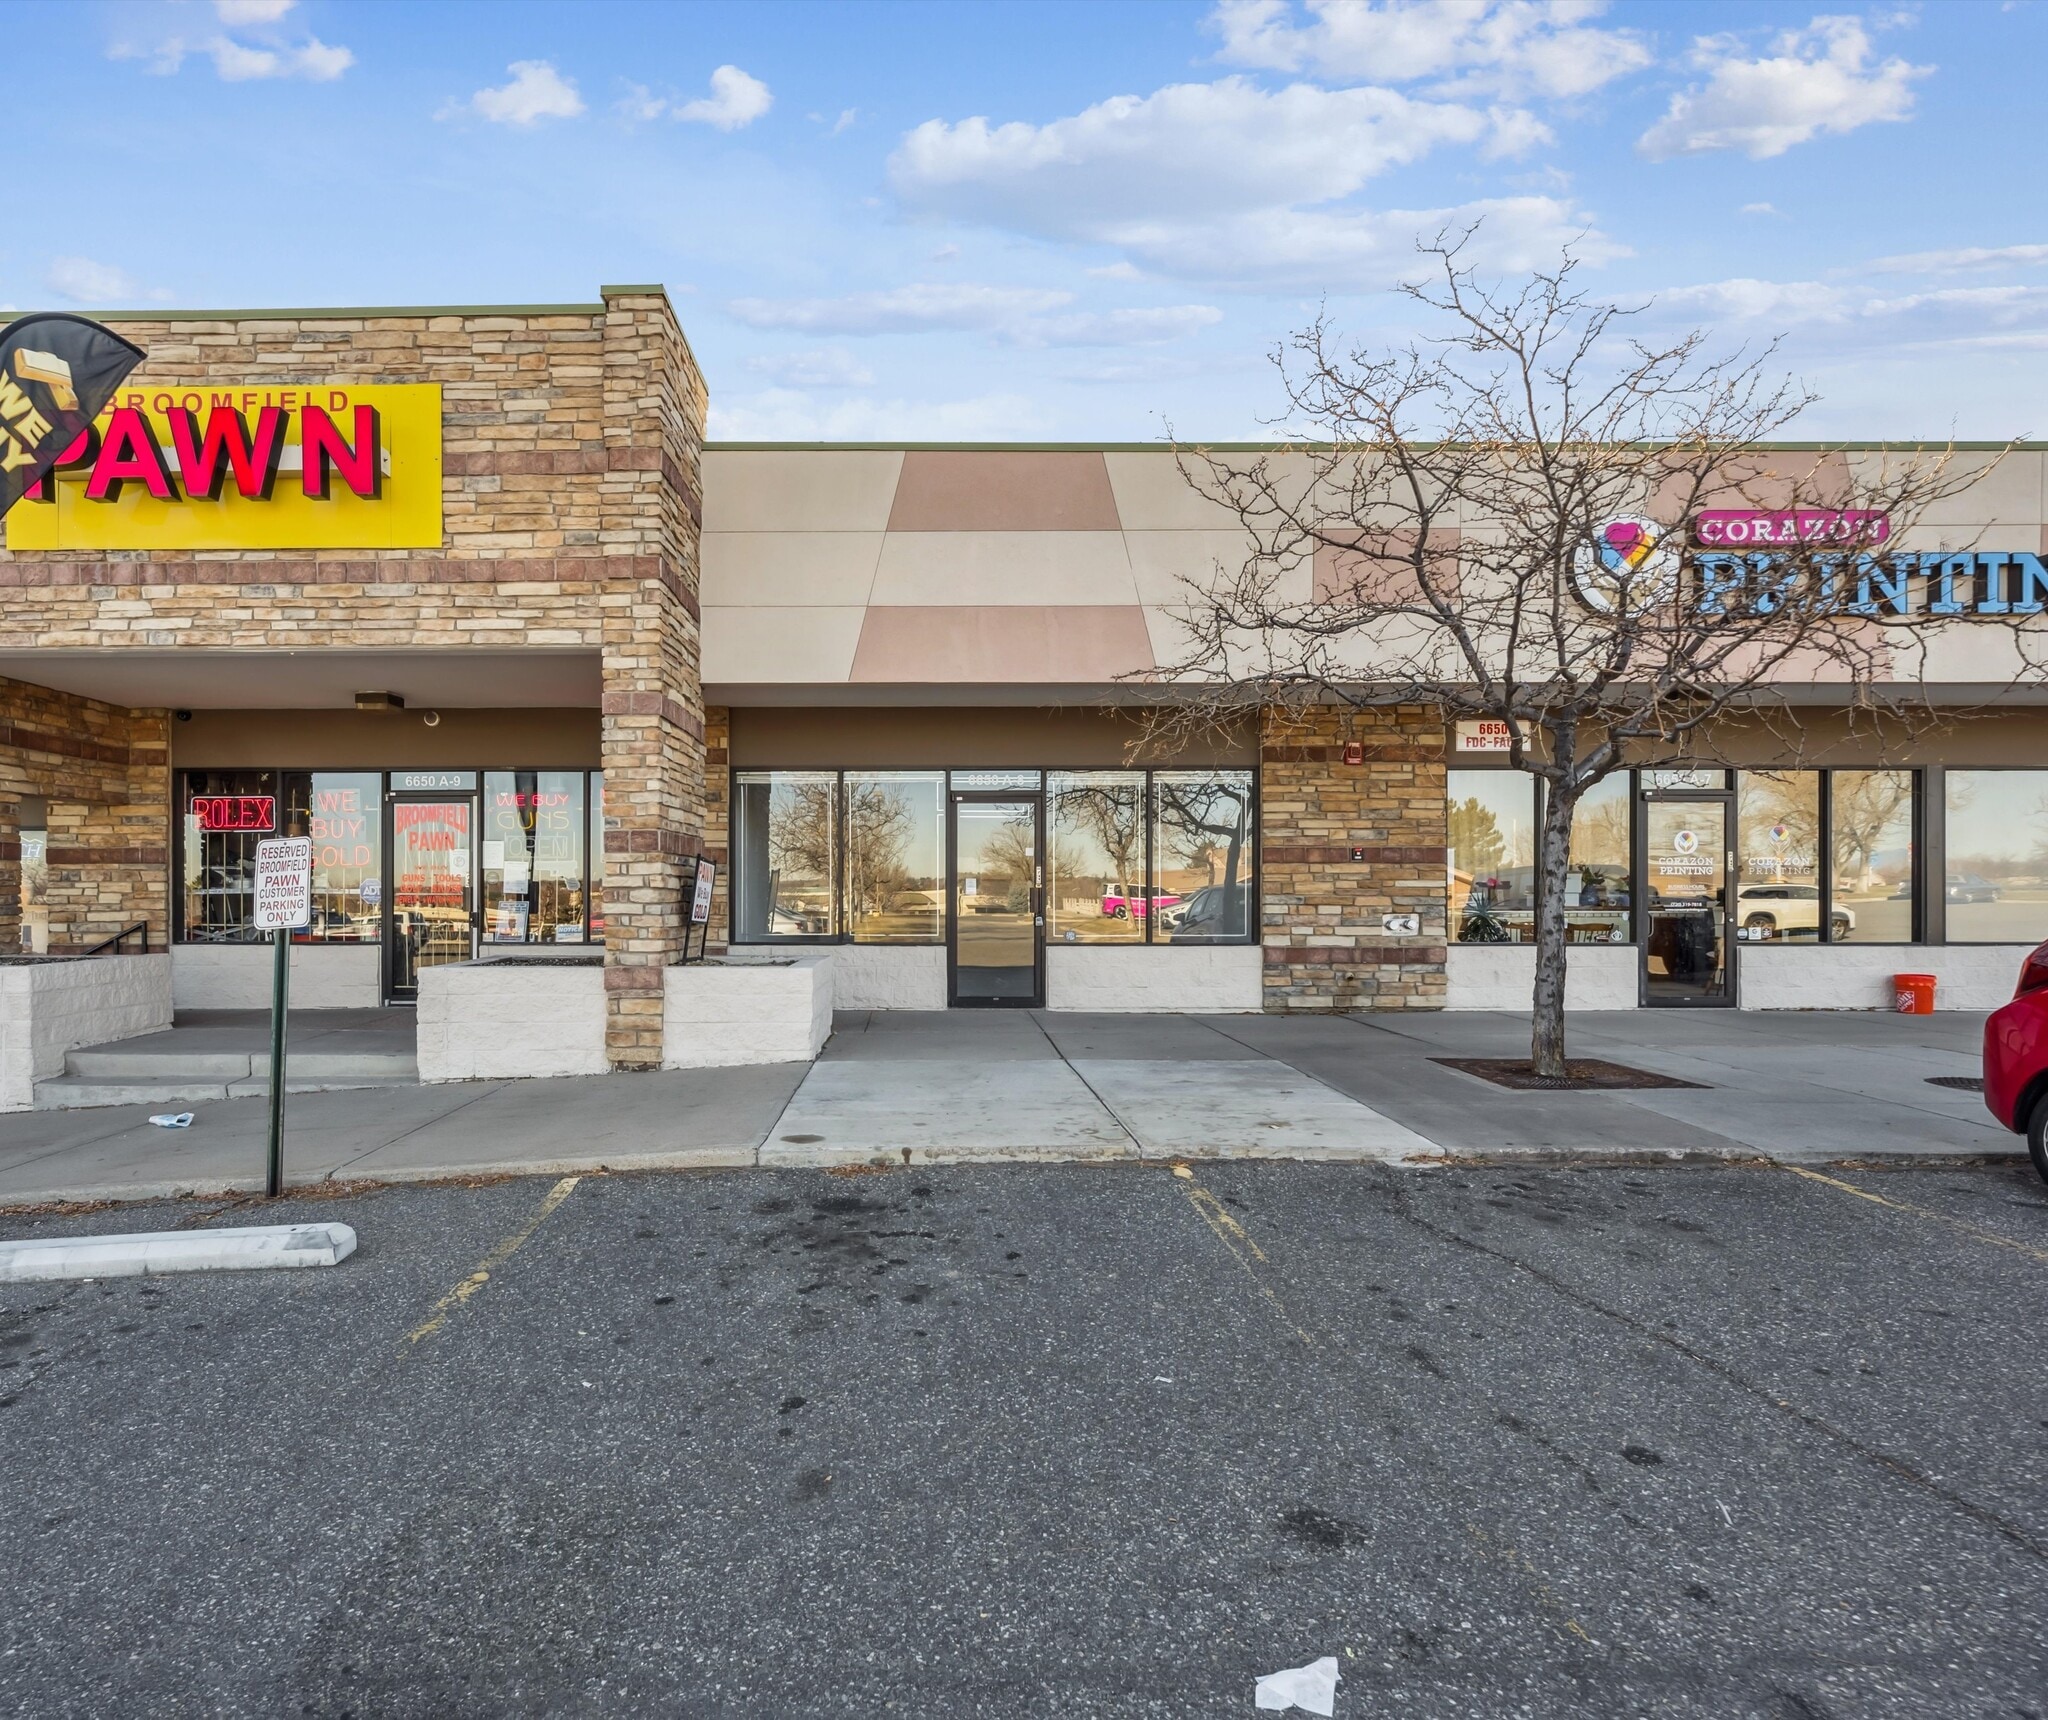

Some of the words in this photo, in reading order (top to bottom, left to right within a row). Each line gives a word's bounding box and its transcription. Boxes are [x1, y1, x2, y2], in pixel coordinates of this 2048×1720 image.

[101, 391, 348, 416] BROOMFIELD
[1479, 723, 1508, 735] 6650
[405, 775, 436, 787] 6650
[439, 775, 462, 787] A-9
[1690, 773, 1712, 785] A-7
[317, 791, 358, 814] WE
[496, 793, 526, 807] WE
[532, 793, 569, 807] BUY
[194, 798, 273, 829] ROLEX
[396, 804, 468, 836] BROOMFIELD
[497, 810, 570, 830] GUNS
[311, 817, 364, 840] BUY
[408, 831, 456, 851] PAWN
[508, 836, 567, 857] OPEN
[261, 844, 308, 859] RESERVED
[259, 858, 308, 874] BROOMFIELD
[1659, 866, 1714, 876] PRINTING
[1748, 867, 1811, 875] PRINTING
[264, 873, 300, 888] PAWN
[401, 873, 426, 883] GUNS
[433, 873, 463, 883] TOOLS
[259, 886, 305, 899] CUSTOMER
[362, 886, 381, 898] ADT
[259, 899, 304, 912] PARKING
[266, 910, 297, 923] ONLY
